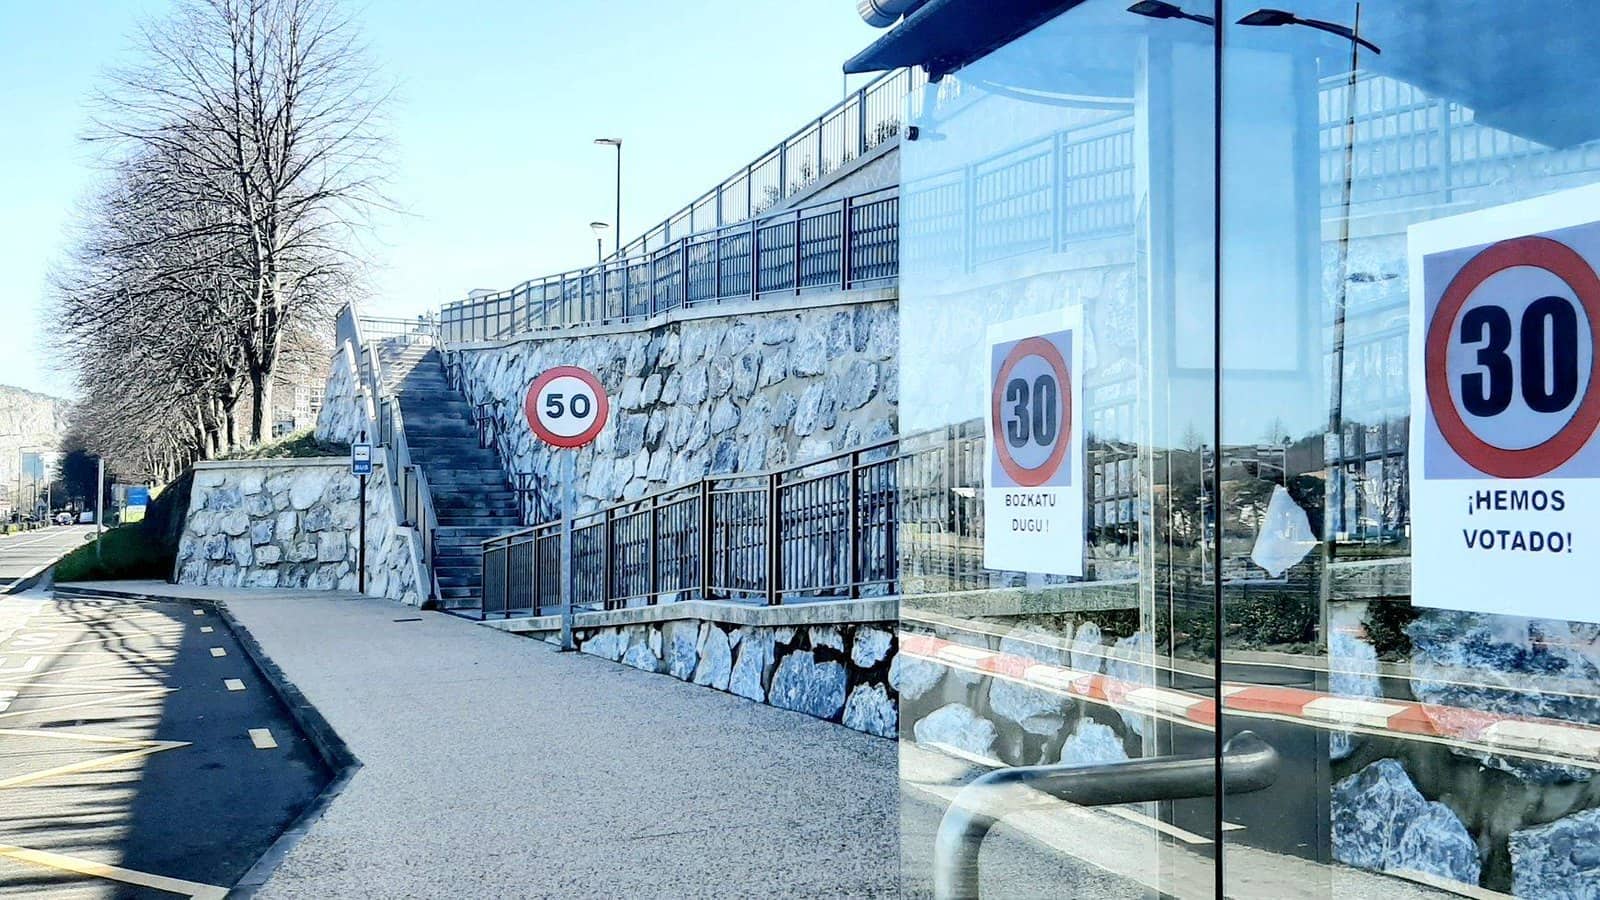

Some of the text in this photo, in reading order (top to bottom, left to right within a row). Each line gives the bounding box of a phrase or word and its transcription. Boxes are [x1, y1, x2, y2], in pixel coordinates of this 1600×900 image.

[1460, 296, 1578, 417] 30
[546, 393, 591, 419] 50
[1006, 374, 1056, 448] 30
[1005, 494, 1056, 507] BOZKATU
[1468, 490, 1566, 514] ¡HEMOS
[1463, 529, 1573, 553] VOTADO!
